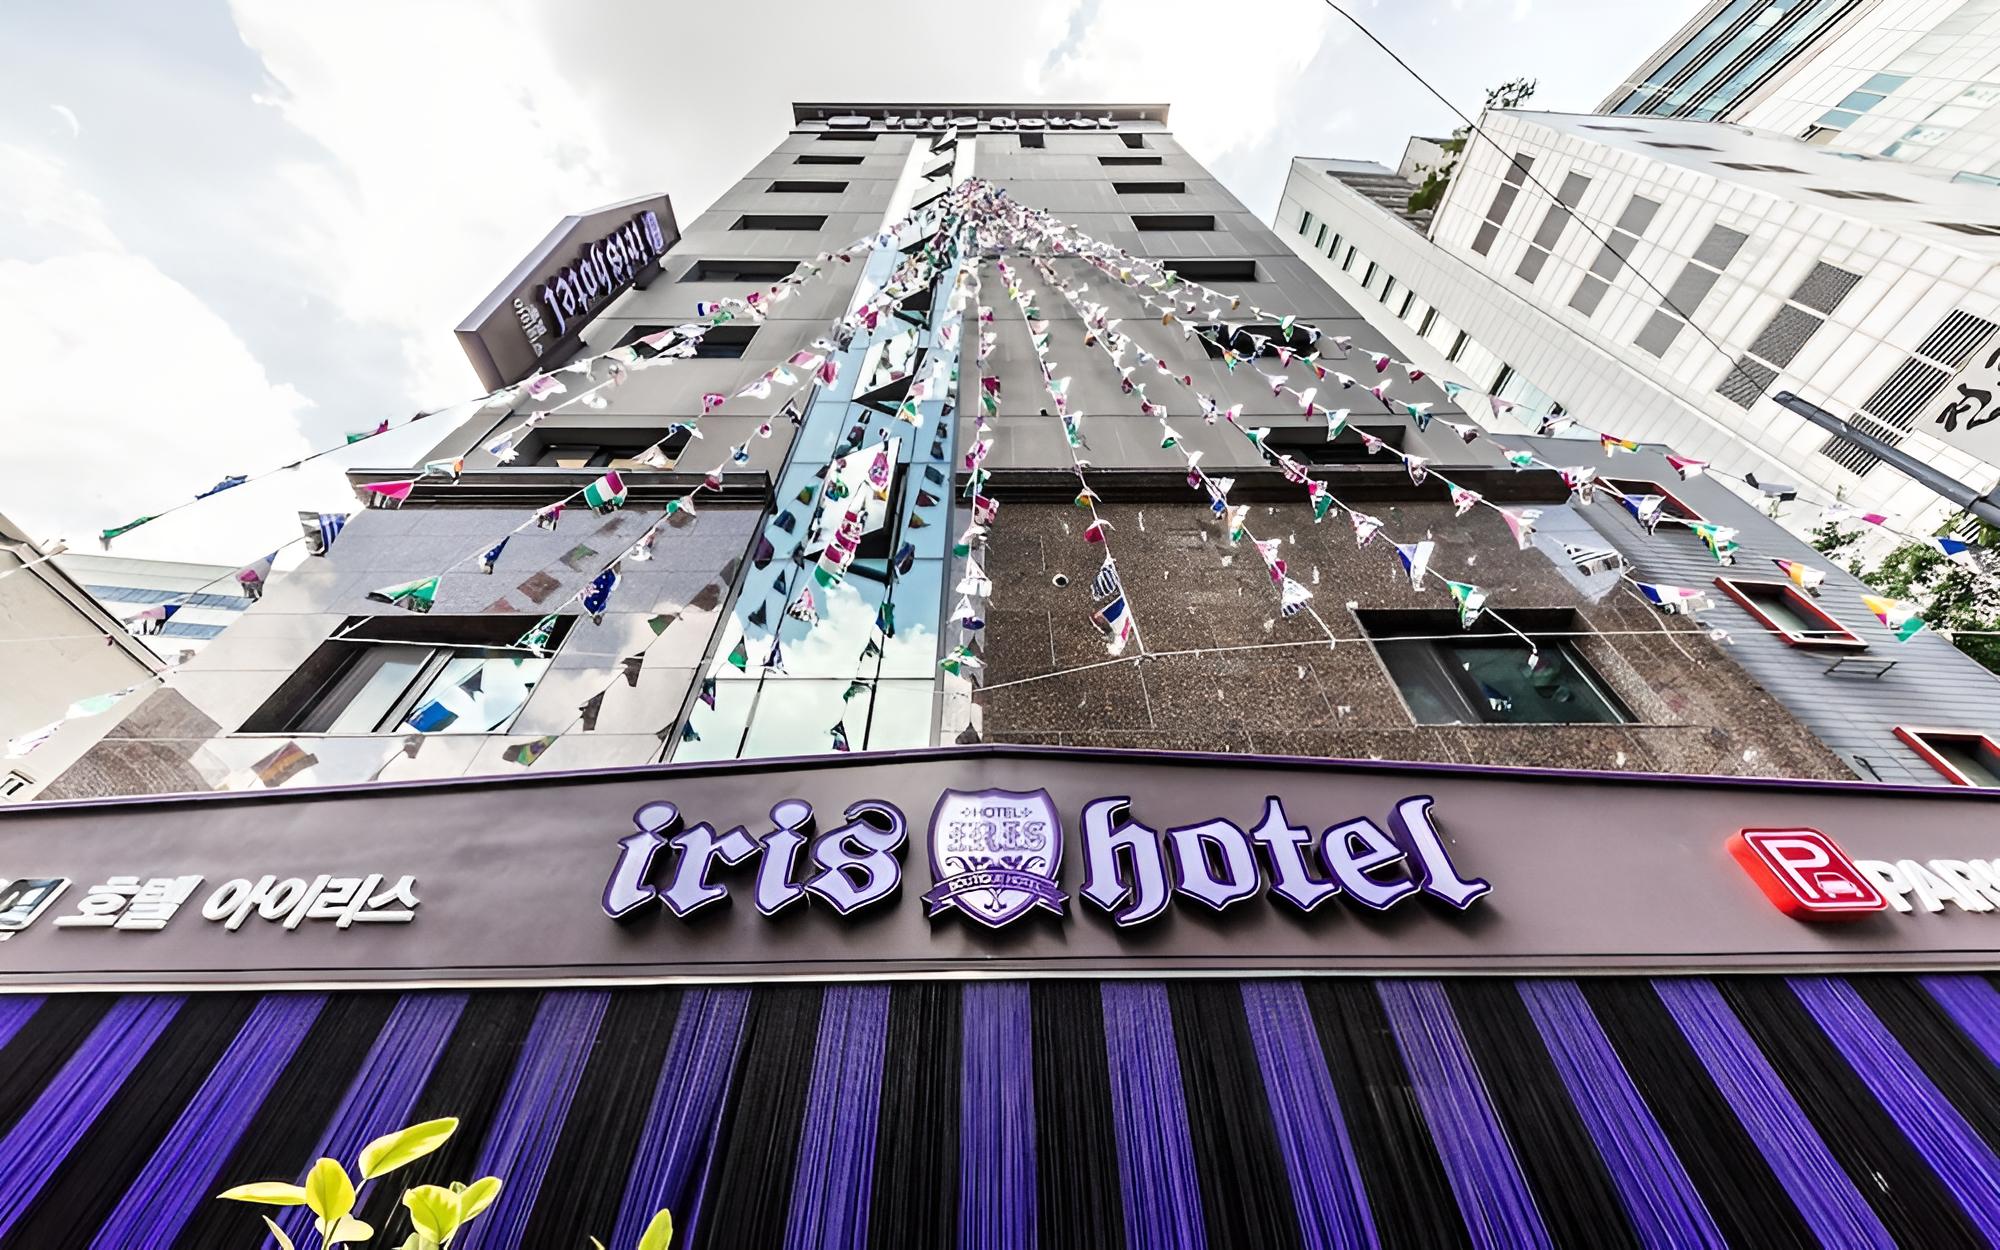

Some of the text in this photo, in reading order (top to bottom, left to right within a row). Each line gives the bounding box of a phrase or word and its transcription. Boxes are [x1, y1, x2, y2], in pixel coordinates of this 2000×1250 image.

[543, 242, 613, 336] hotel
[947, 820, 1047, 853] IRIS
[973, 806, 1022, 819] HOTEL
[600, 795, 1494, 927] iris hotel
[53, 873, 421, 931] 호텔 아이리스
